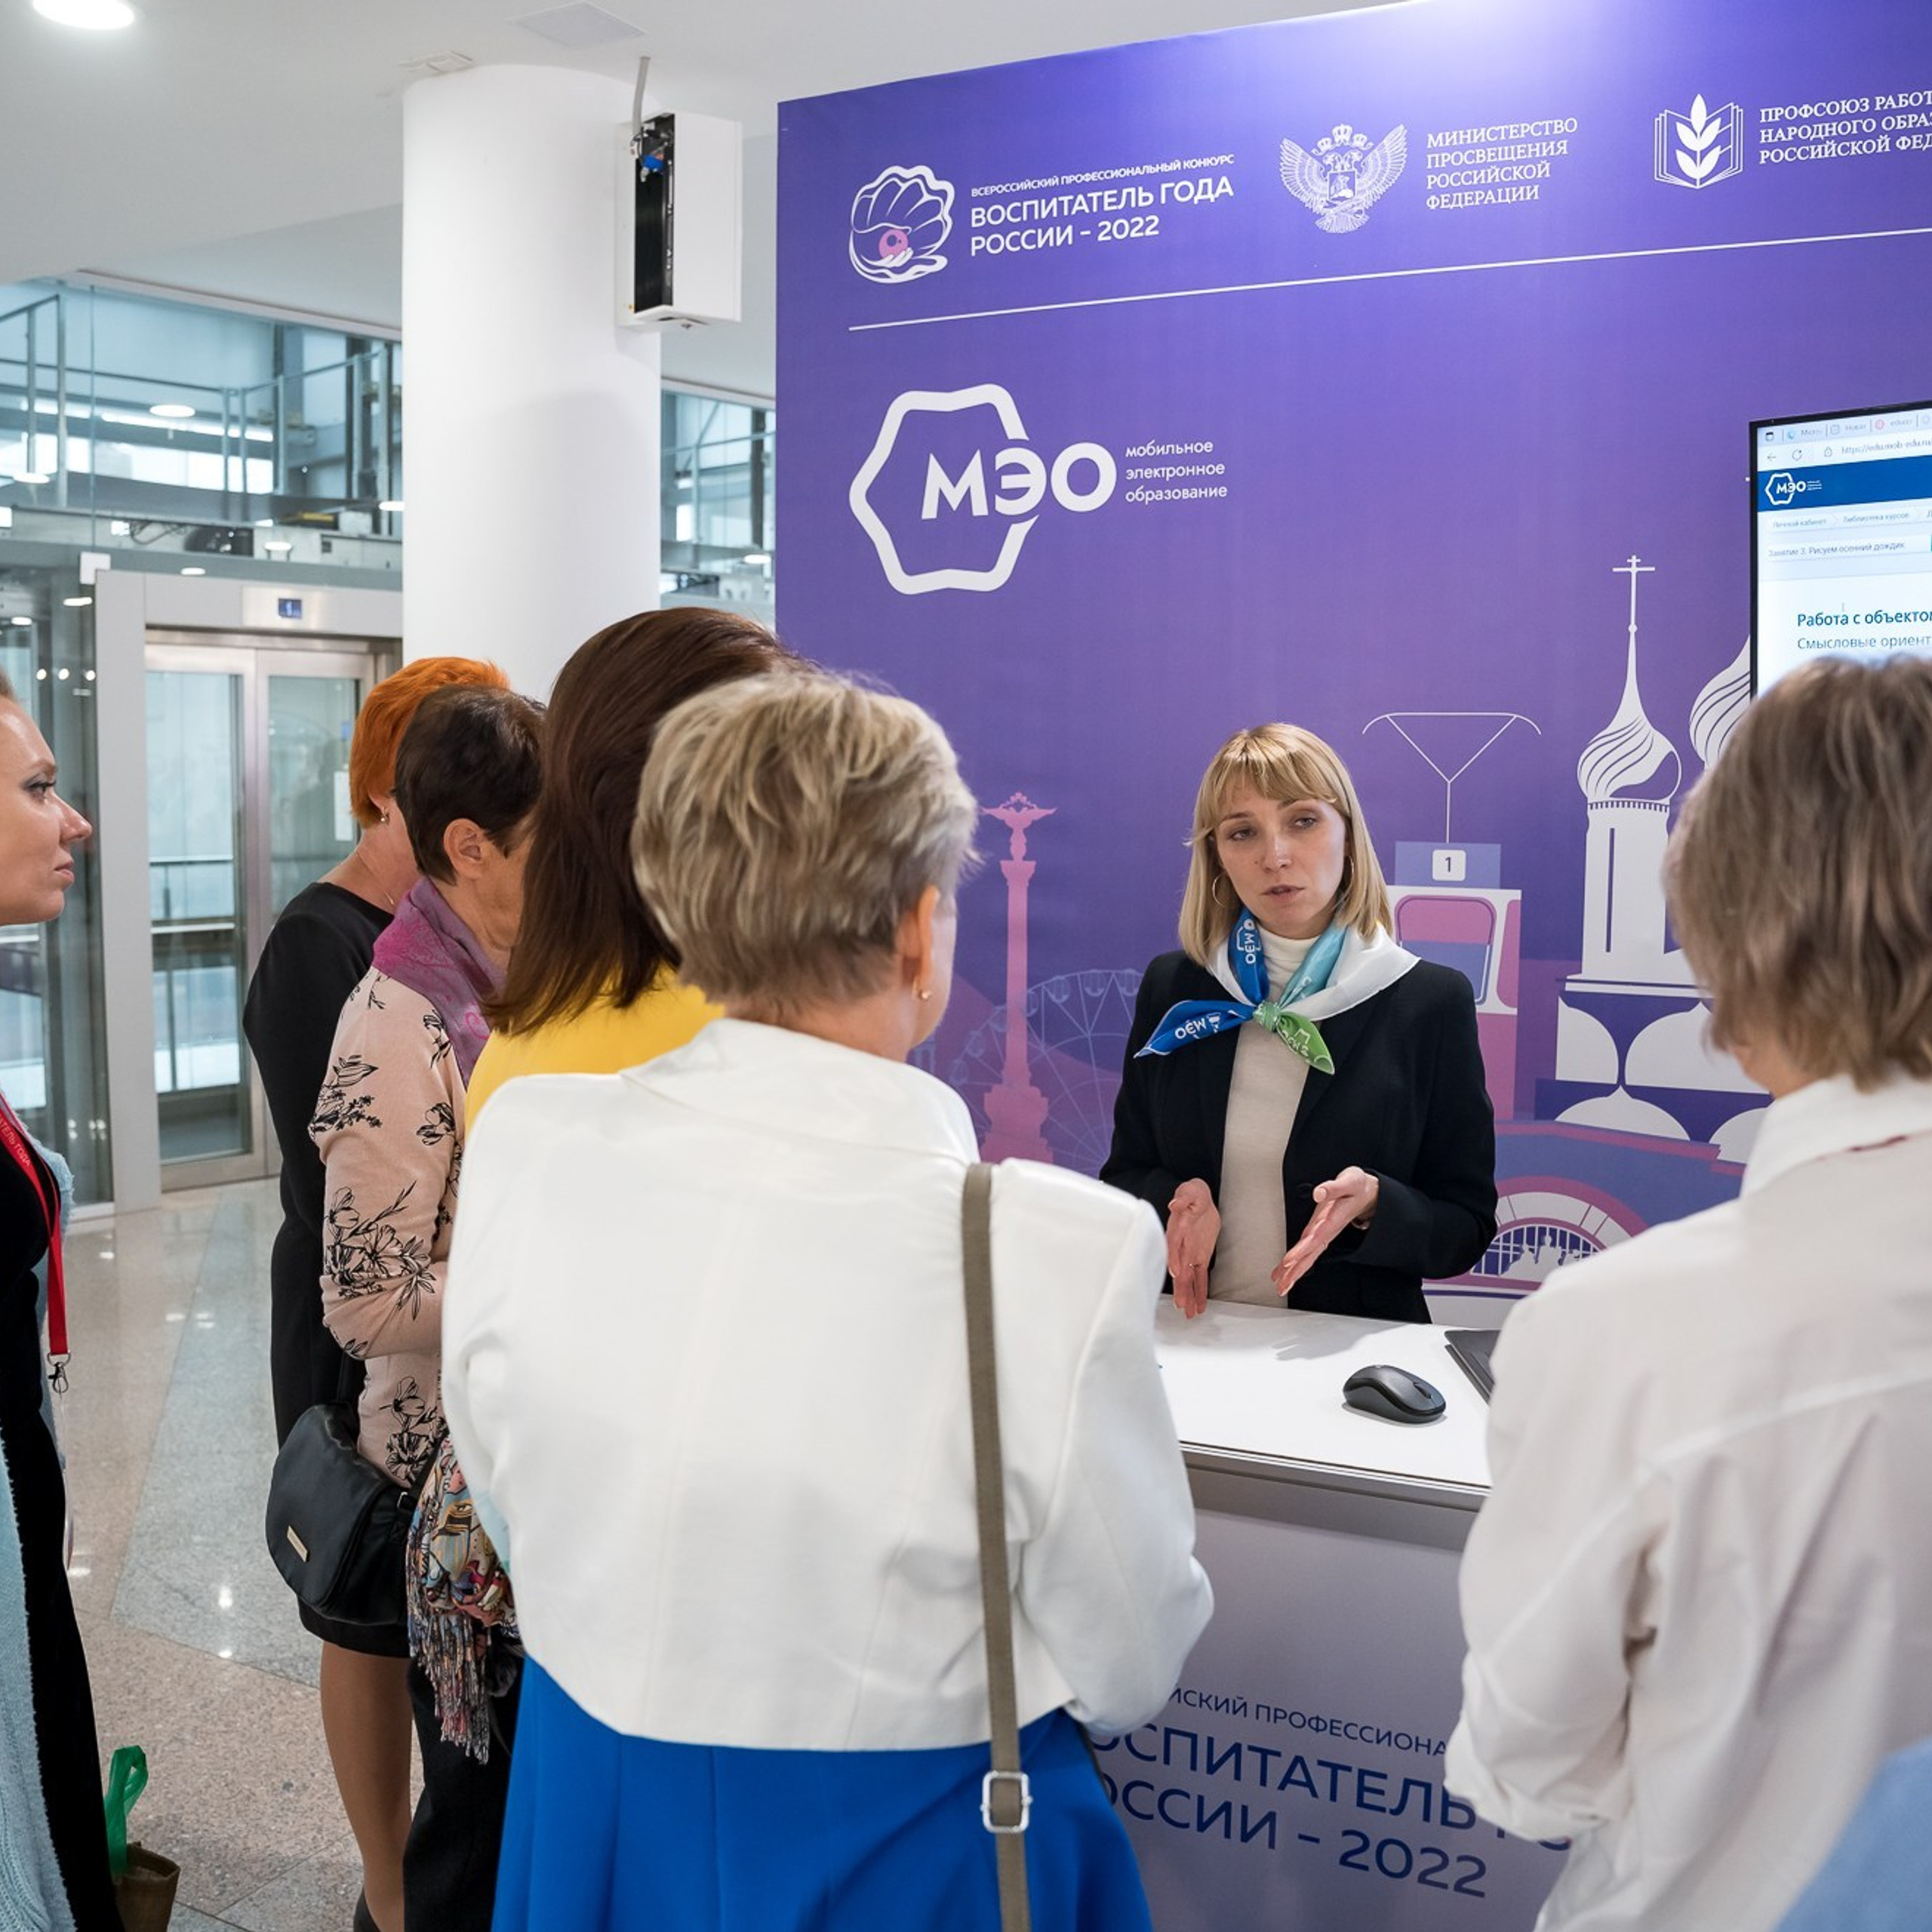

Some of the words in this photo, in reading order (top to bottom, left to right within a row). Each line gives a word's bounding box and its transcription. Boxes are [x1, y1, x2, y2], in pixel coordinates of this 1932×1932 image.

[1760, 98, 1869, 123] ПРОФСОЮЗ
[1427, 117, 1578, 149] МИНИСТЕРСТВО
[1760, 118, 1876, 143] НАРОДНОГО
[1426, 140, 1568, 169] ПРОСВЕЩЕНИЯ
[1760, 134, 1890, 165] РОССИЙСКОЙ
[971, 176, 1059, 197] ВСЕРОССИЙСКИЙ
[1060, 158, 1181, 185] ПРОФЕССИОНАЛЬНЫЙ
[1183, 154, 1235, 171] КОНКУРС
[1426, 160, 1551, 189] РОССИЙСКОЙ
[971, 186, 1154, 228] ВОСПИТАТЕЛЬ
[1160, 175, 1234, 205] ГОДА
[1426, 185, 1540, 210] ФЕДЕРАЦИИ
[971, 225, 1073, 257] РОССИИ
[1097, 215, 1159, 242] 2022
[1125, 440, 1214, 457] мобильное
[921, 442, 1117, 519] МЭО
[1126, 462, 1226, 481] электронное
[1125, 485, 1227, 505] образование
[1776, 481, 1806, 494] МЭО
[1809, 546, 1838, 555] Рисуем
[1798, 612, 1848, 626] Работа
[1854, 614, 1860, 624] с
[1865, 610, 1932, 624] объекто
[1798, 638, 1876, 649] Смысловые
[1881, 636, 1931, 649] ориент
[1445, 857, 1451, 872] 1
[1339, 1829, 1487, 1897] 2022
